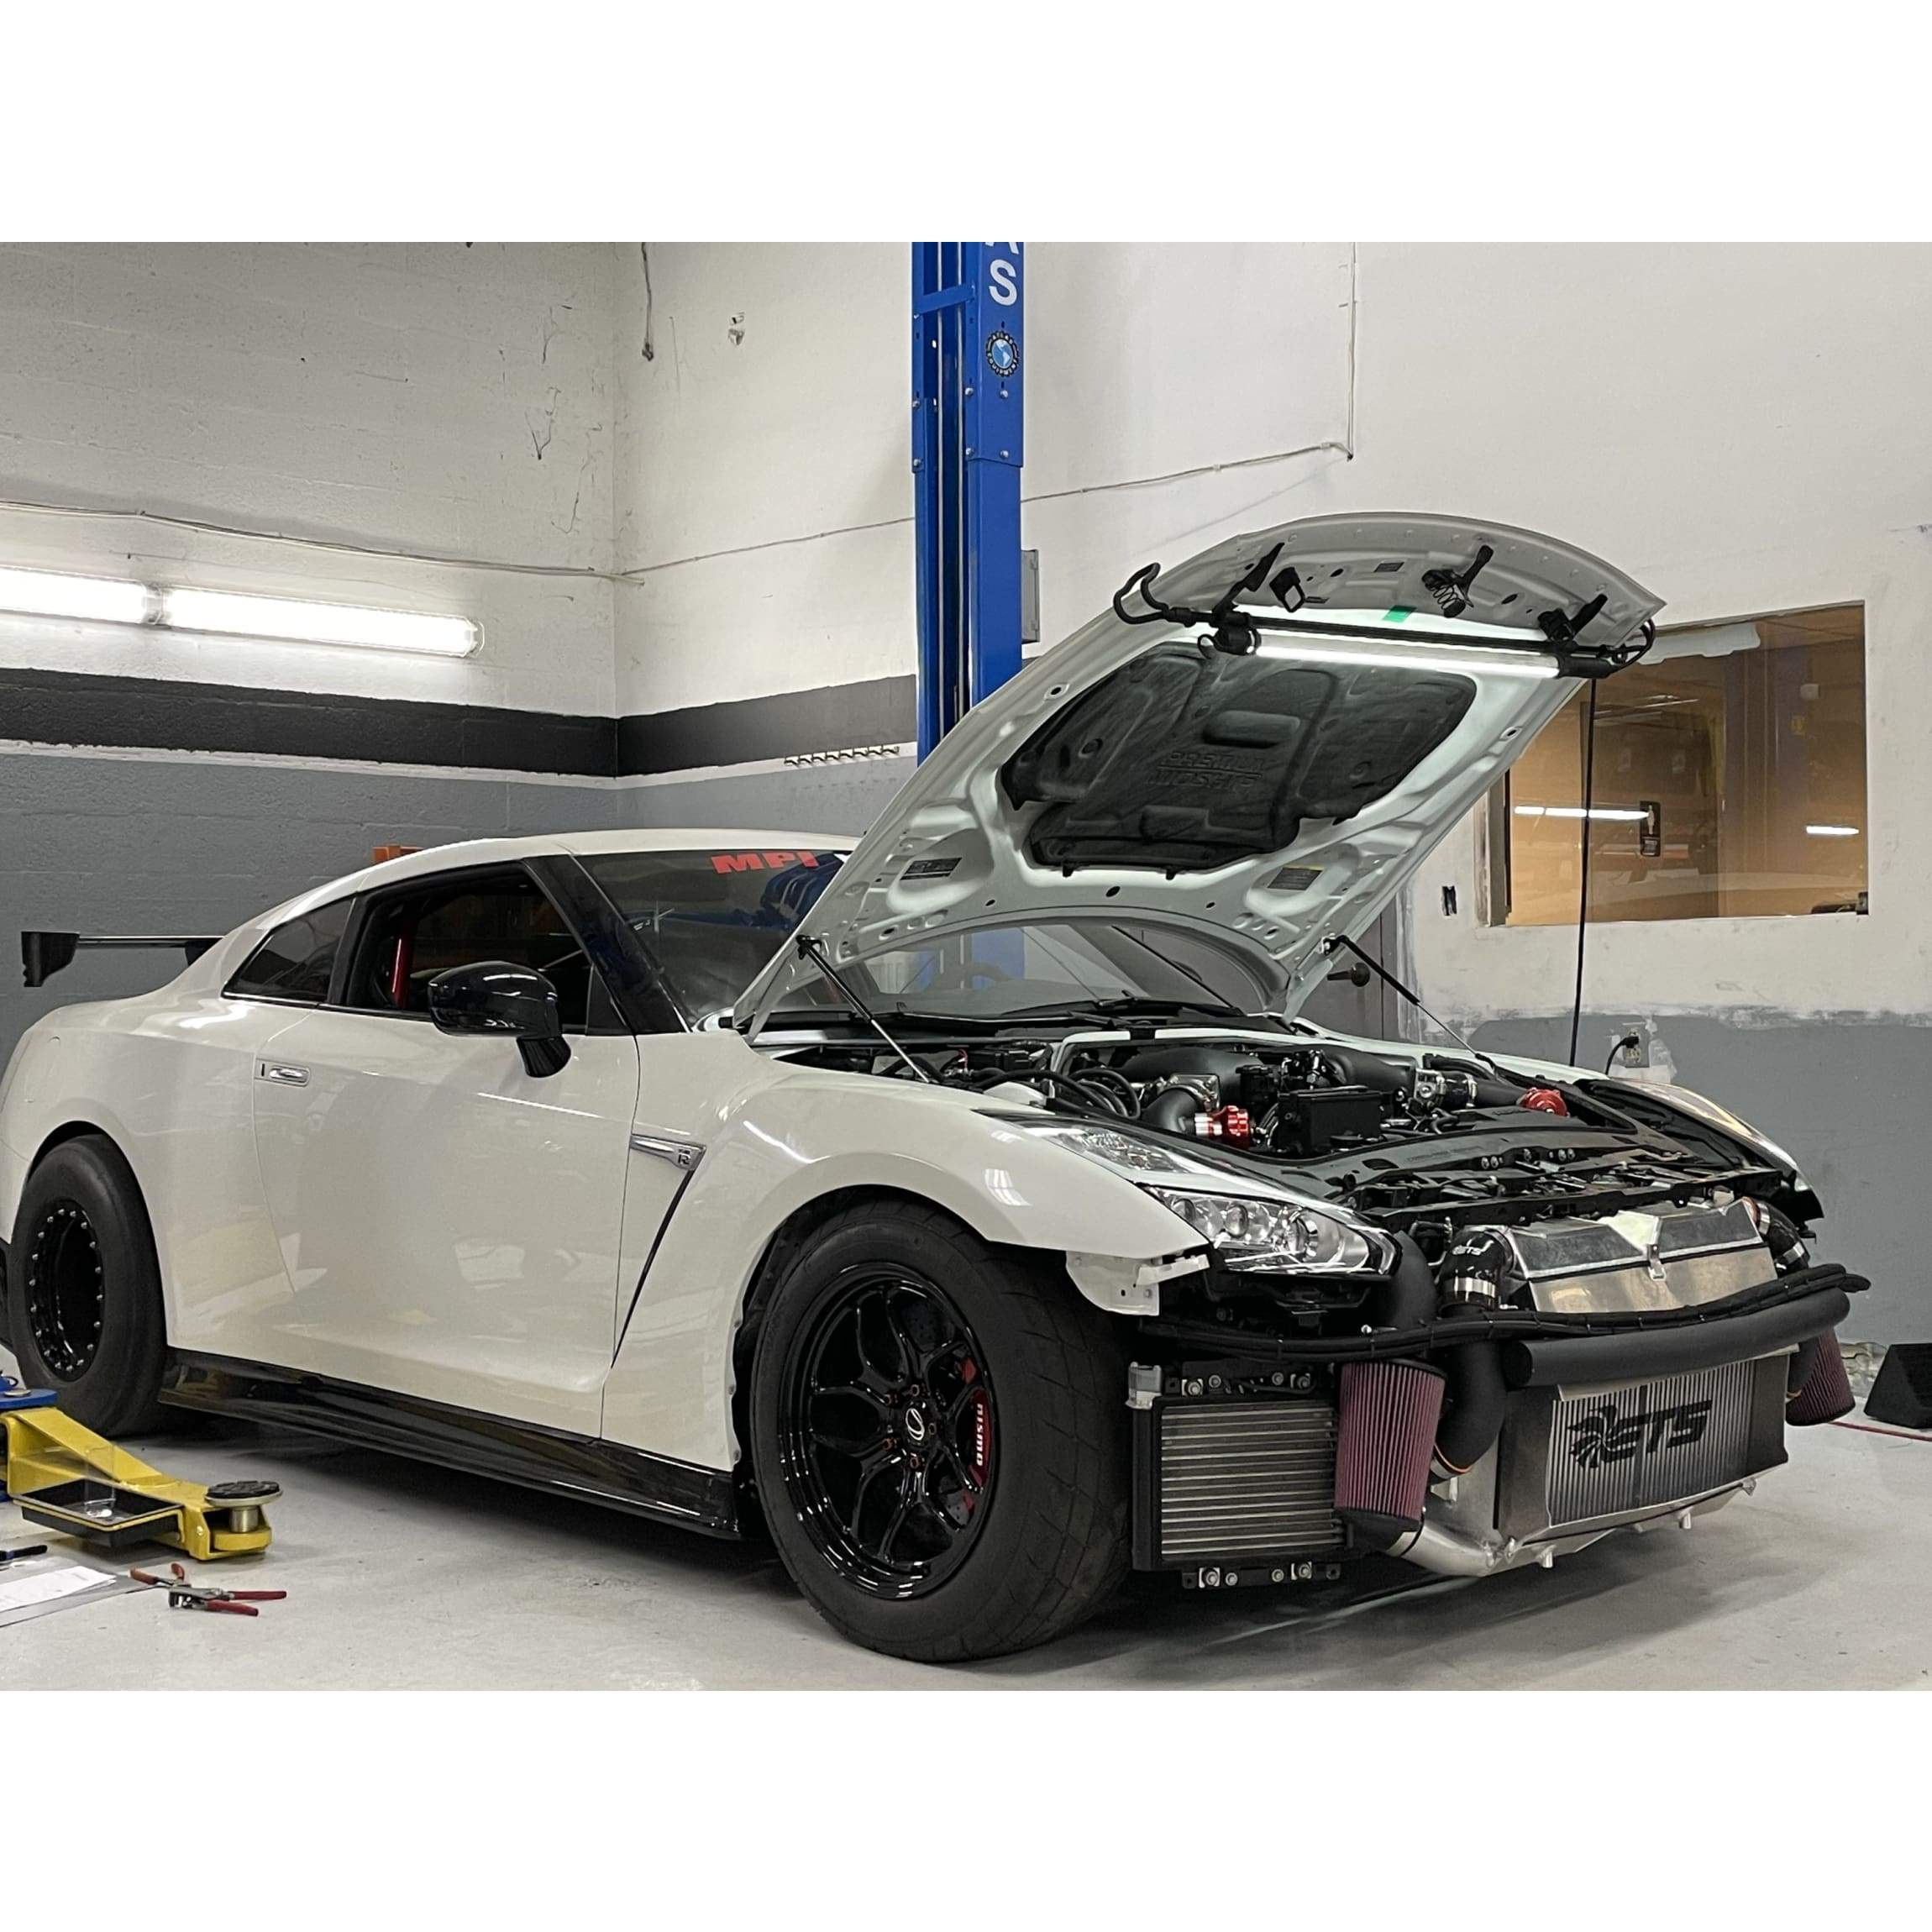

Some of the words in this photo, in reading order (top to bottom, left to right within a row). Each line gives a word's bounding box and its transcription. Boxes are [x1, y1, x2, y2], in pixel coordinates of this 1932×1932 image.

[985, 242, 1019, 306] S
[711, 851, 819, 874] MPI
[1601, 1400, 1713, 1463] ETS
